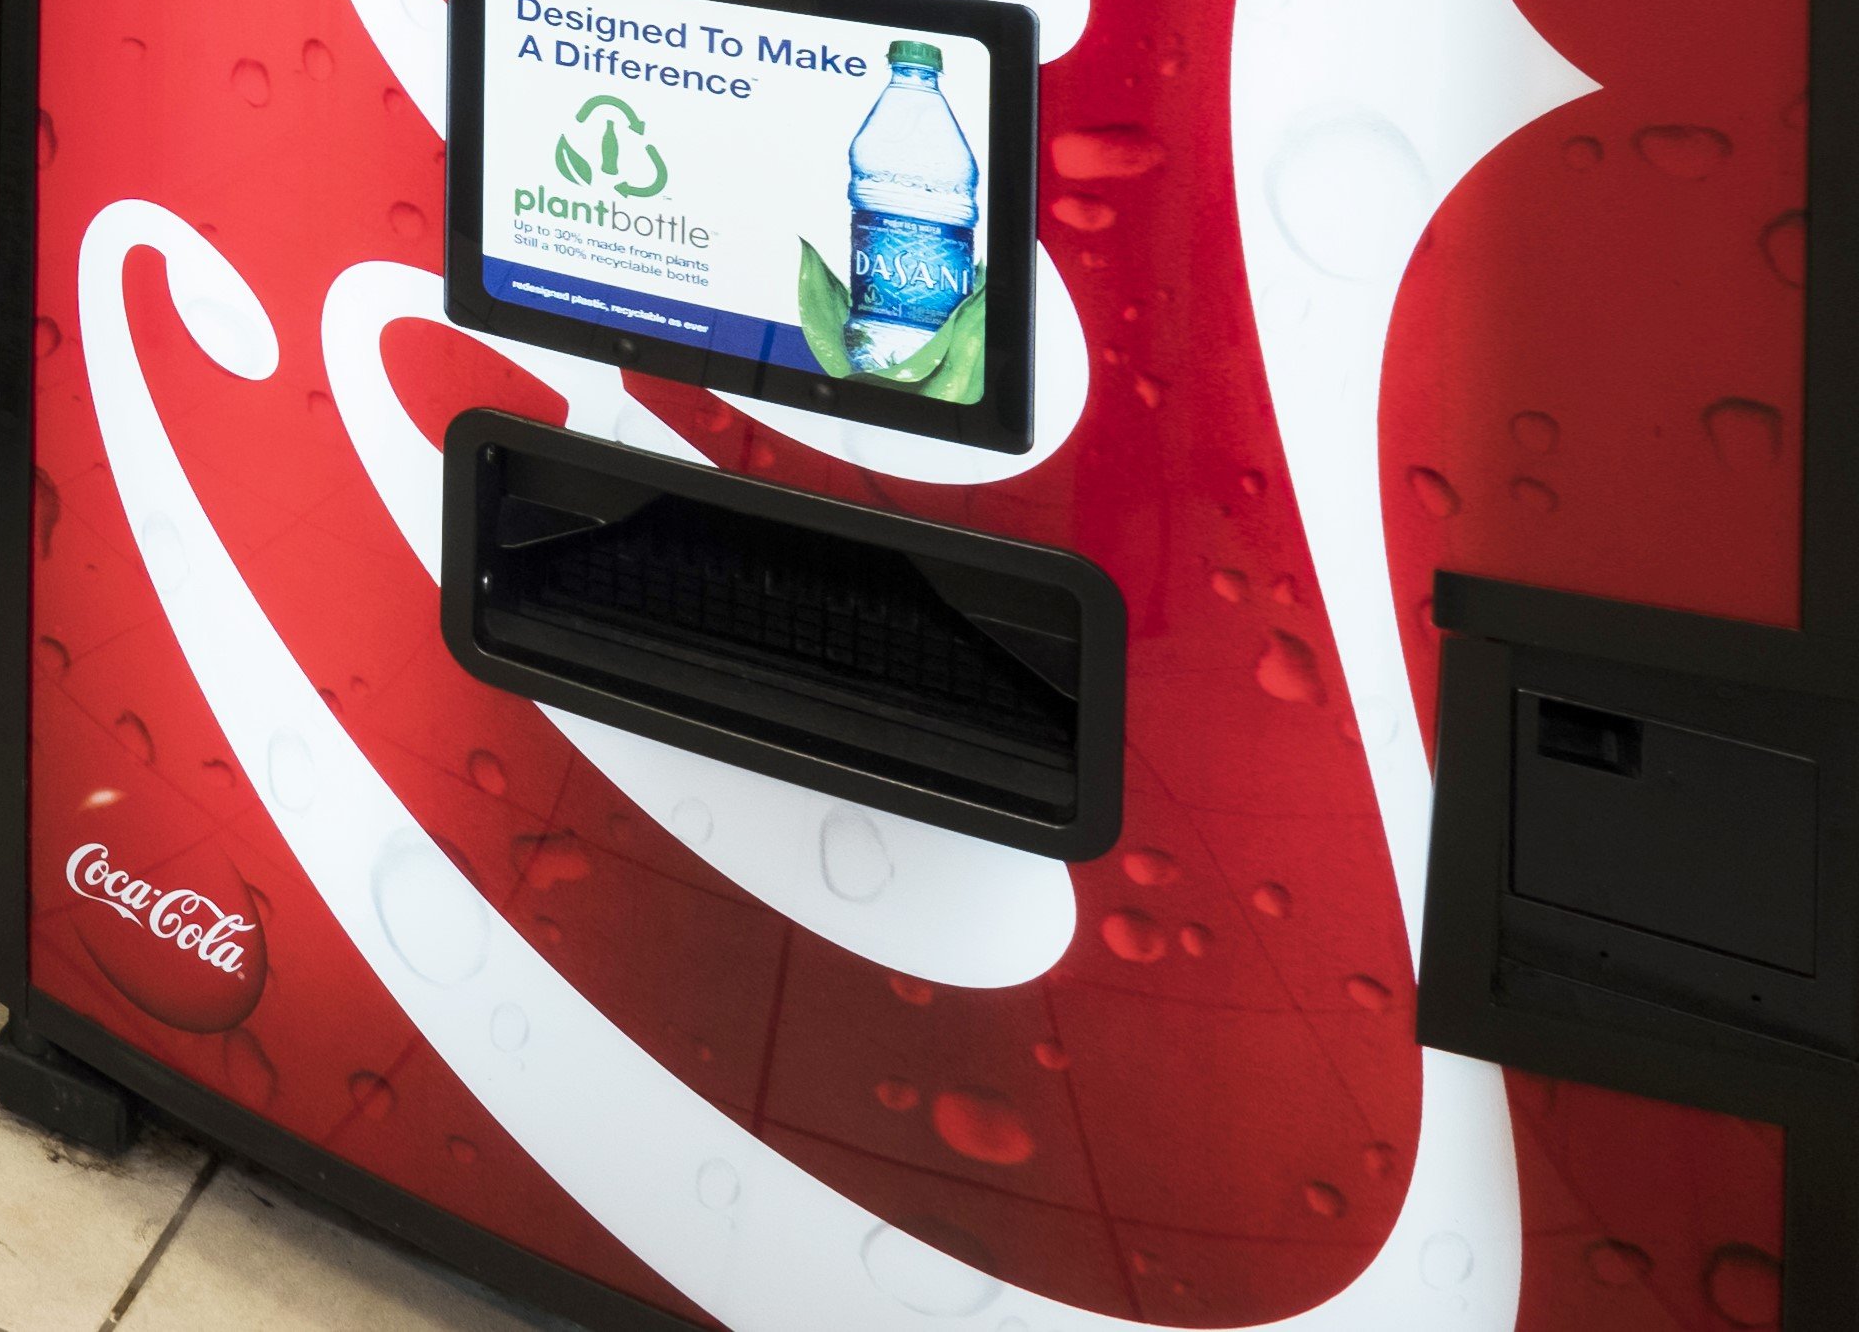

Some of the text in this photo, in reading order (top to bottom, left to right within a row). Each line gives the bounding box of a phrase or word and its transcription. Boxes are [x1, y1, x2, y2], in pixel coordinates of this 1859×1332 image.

[516, 35, 754, 100] A Difference
[699, 24, 744, 58] To
[757, 34, 869, 80] Make
[513, 183, 712, 250] plantbottle
[513, 219, 710, 273] Up to 30% made from plants
[514, 234, 710, 287] Still a 100% recyclable bottle
[856, 249, 968, 296] DASANI
[511, 280, 570, 302] redesigned
[683, 321, 710, 333] ever
[65, 842, 257, 976] Coca-Cola
